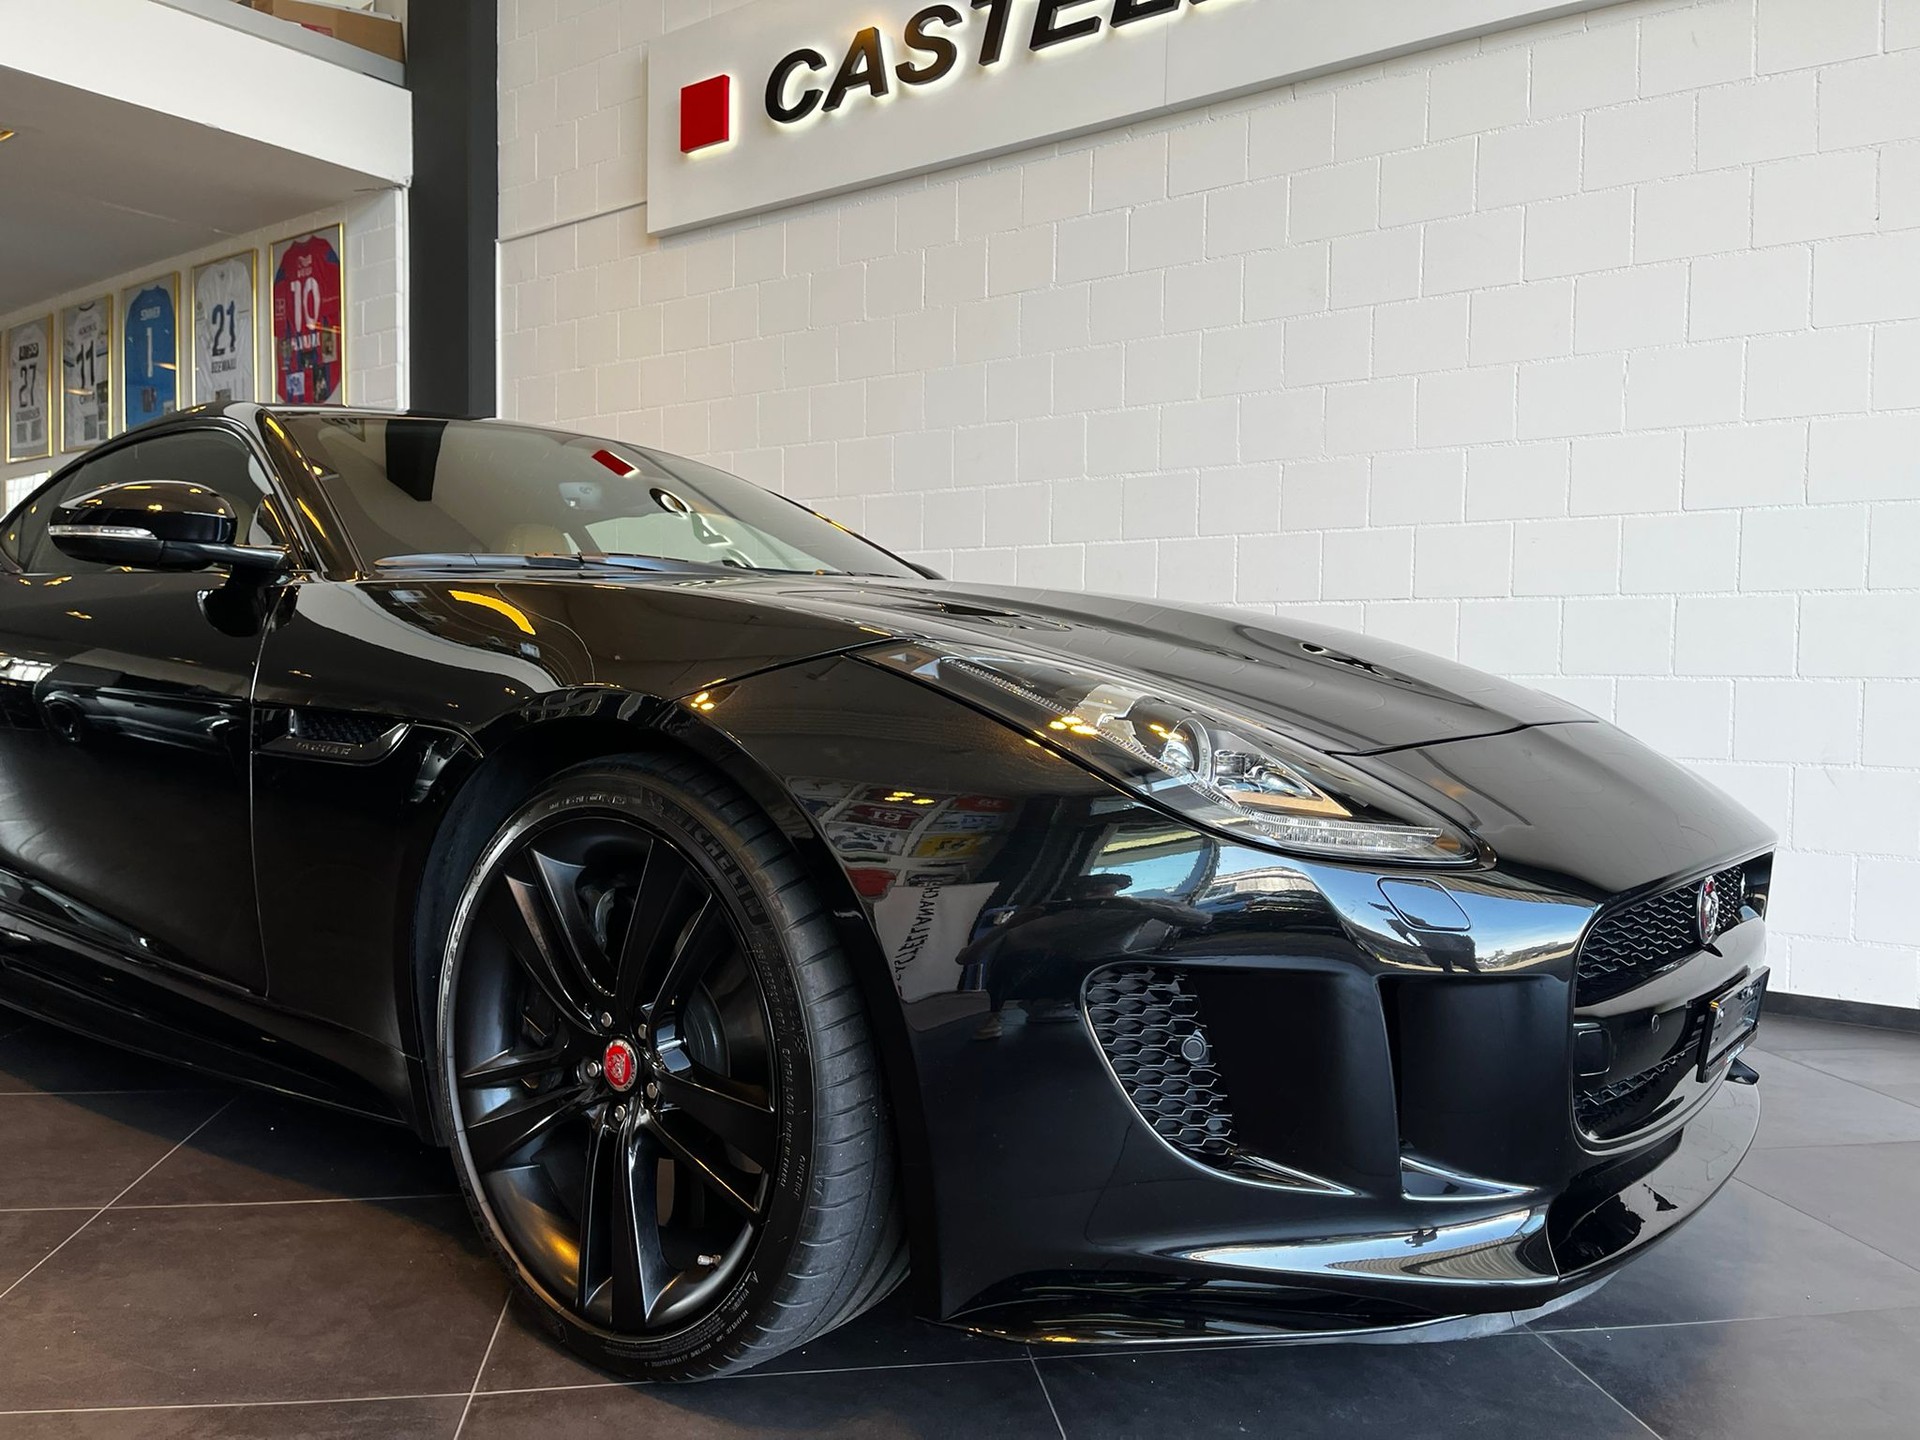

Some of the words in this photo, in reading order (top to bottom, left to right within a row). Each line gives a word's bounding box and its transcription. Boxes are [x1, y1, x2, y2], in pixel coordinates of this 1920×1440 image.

[211, 299, 236, 357] 21
[290, 277, 321, 332] 10
[19, 363, 37, 407] 27
[76, 340, 95, 389] 11
